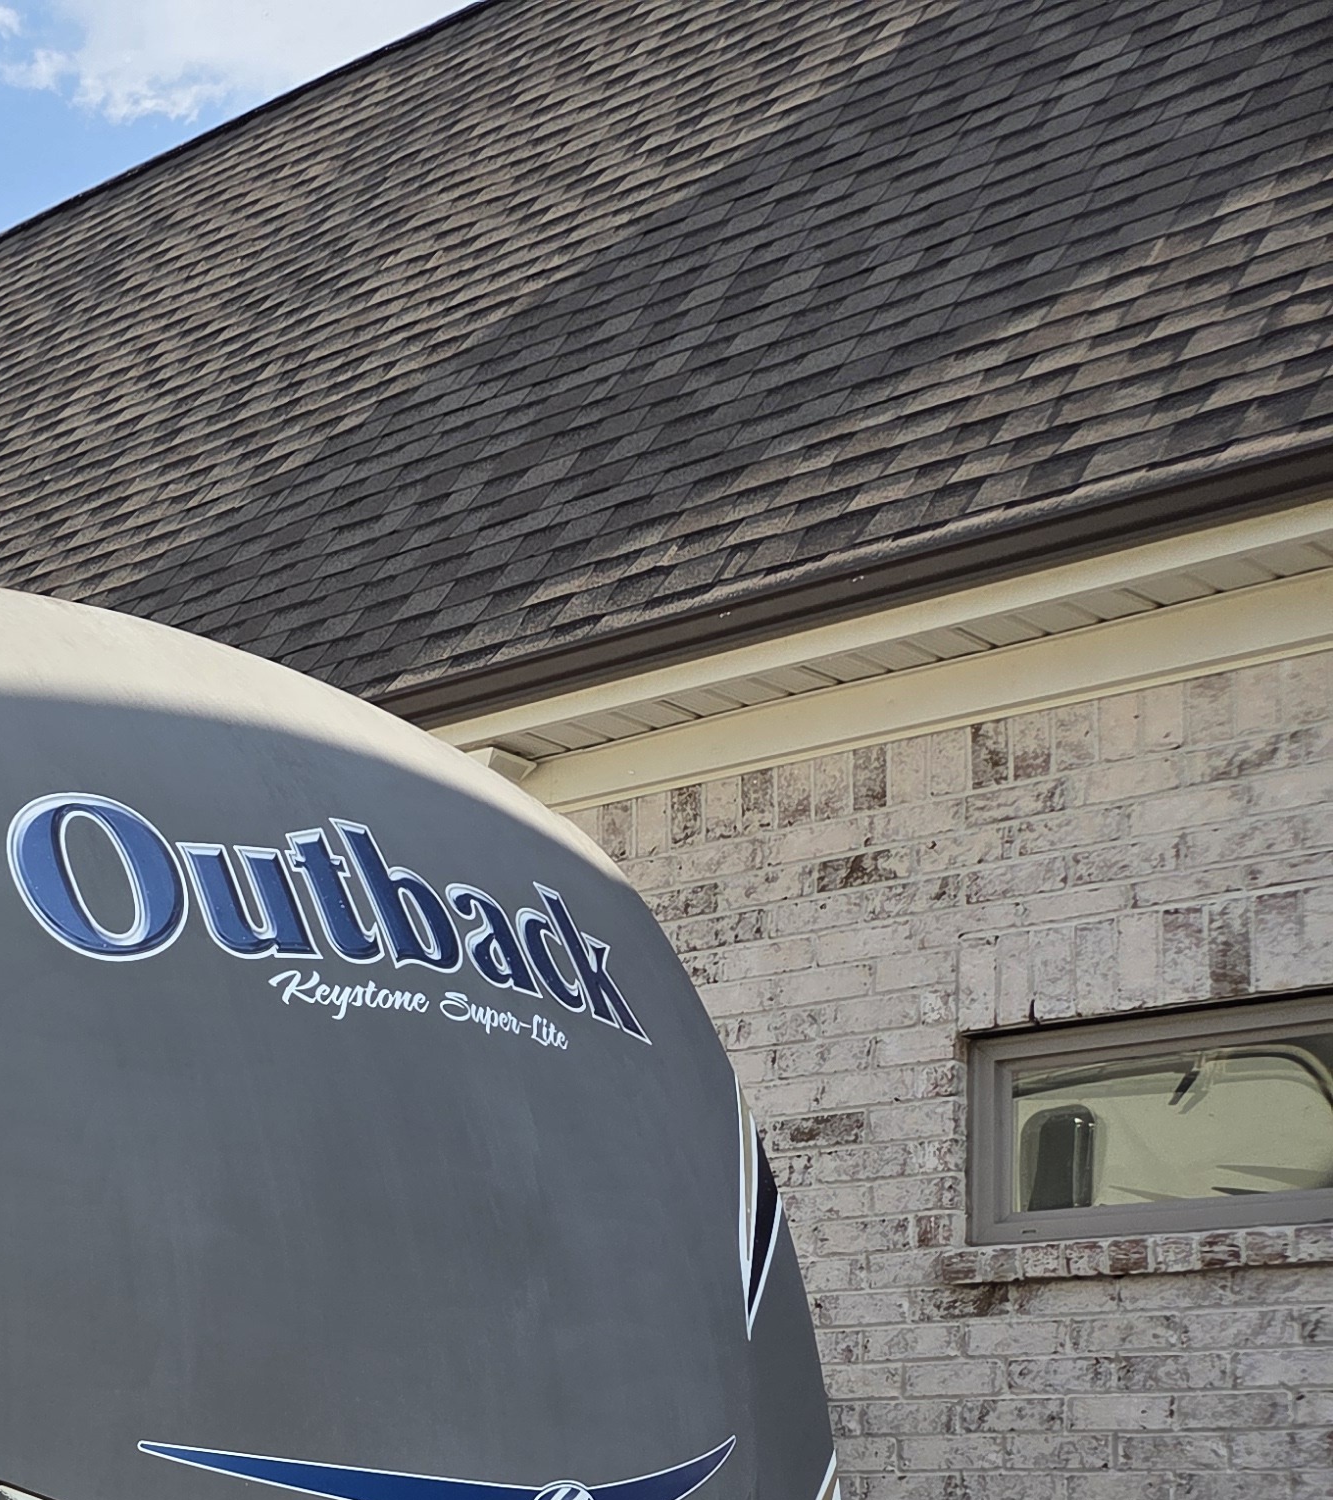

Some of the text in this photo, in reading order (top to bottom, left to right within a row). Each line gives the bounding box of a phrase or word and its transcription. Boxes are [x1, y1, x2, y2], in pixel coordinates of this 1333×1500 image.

[6, 792, 652, 1044] Outback
[268, 970, 569, 1049] Keystone Super-Lite
